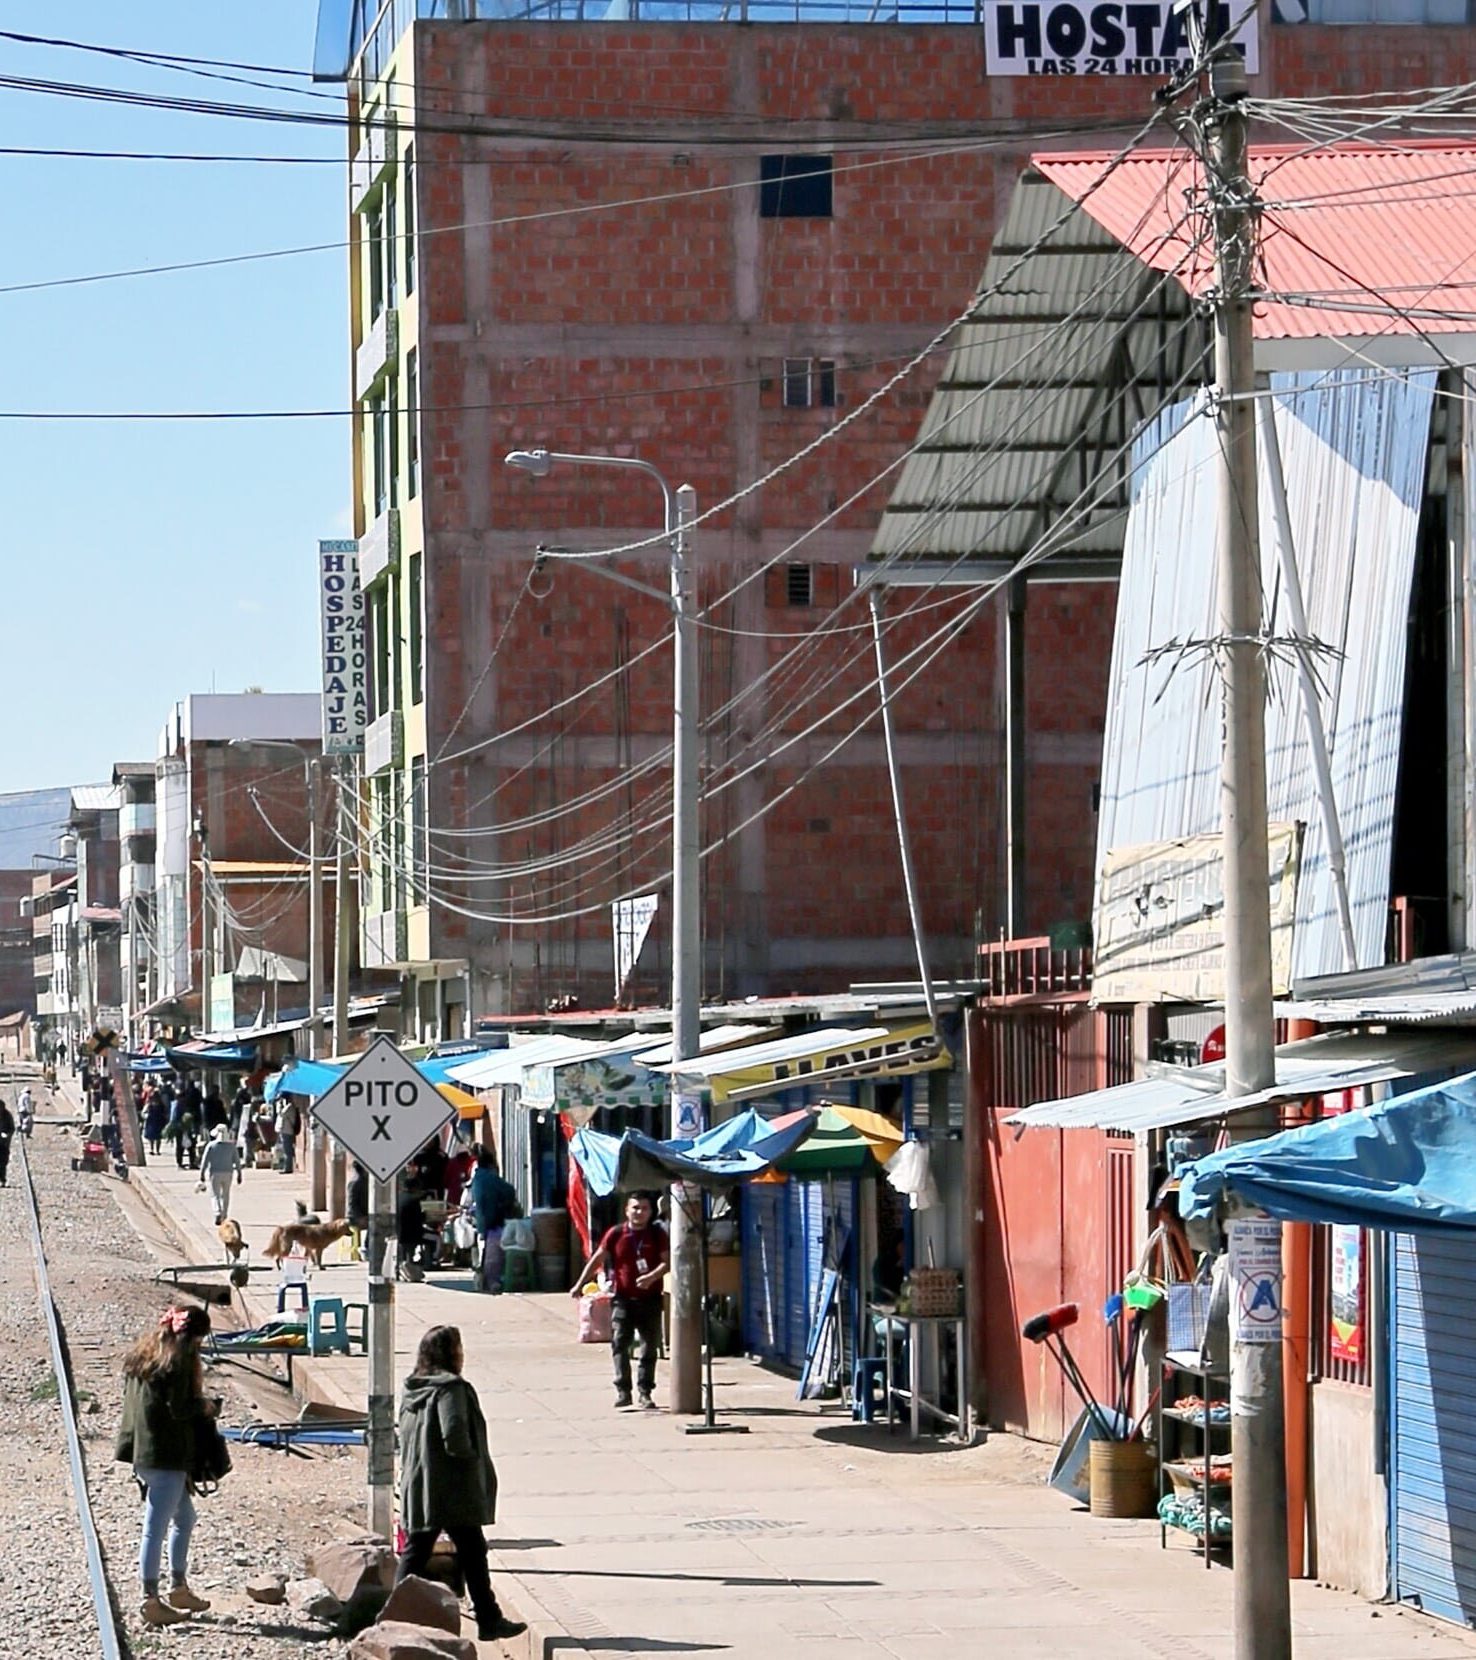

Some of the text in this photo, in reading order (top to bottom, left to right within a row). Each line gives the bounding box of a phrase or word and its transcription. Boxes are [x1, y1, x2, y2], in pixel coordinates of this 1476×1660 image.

[1027, 58, 1077, 75] LAS
[1084, 57, 1118, 75] 24
[323, 554, 348, 734] HOSPEDAJE
[345, 558, 366, 726] LAS 24 HORAS
[345, 1080, 419, 1107] PITO
[371, 1115, 392, 1141] X
[1251, 1279, 1278, 1311] A
